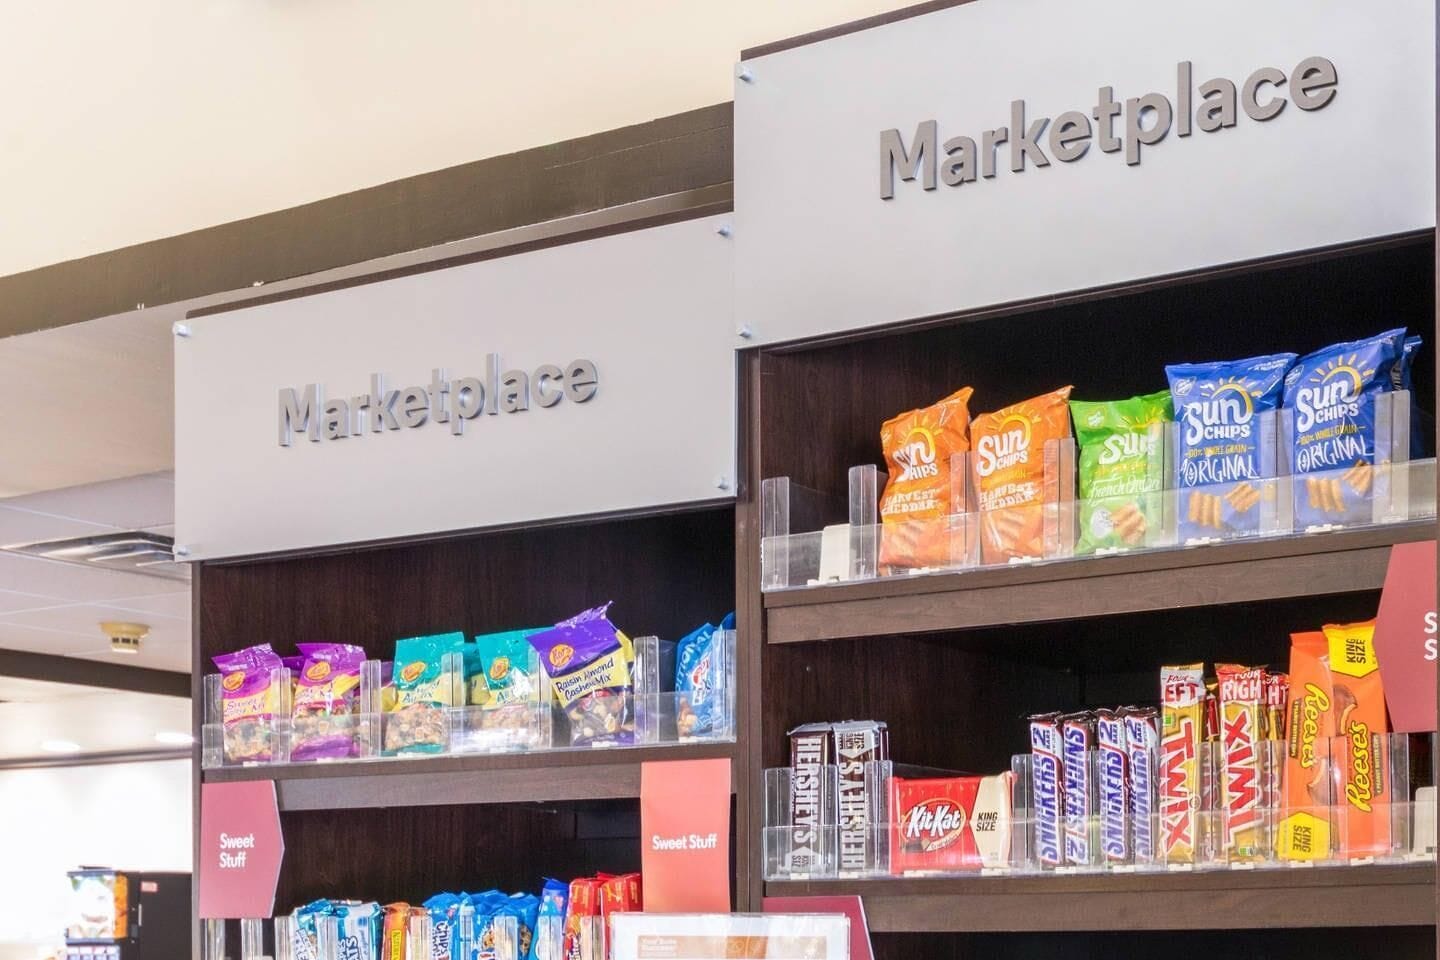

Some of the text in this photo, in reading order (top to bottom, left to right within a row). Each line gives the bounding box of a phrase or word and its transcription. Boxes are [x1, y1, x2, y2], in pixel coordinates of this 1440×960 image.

[879, 55, 1338, 200] Marketplace
[278, 353, 599, 447] Marketplace
[1296, 378, 1360, 433] Sun
[1316, 402, 1359, 423] CHIPS
[1185, 398, 1252, 446] Sun
[1204, 424, 1250, 440] CHIPS
[976, 428, 1031, 477] Sun
[995, 450, 1029, 470] CHIPS
[1346, 638, 1356, 664] KING
[1356, 638, 1366, 664] SIZE
[556, 658, 615, 693] Raisin Almond
[564, 674, 613, 702] Cashew Mix
[1033, 729, 1047, 747] 2
[1100, 724, 1112, 744] 2
[1224, 710, 1263, 846] TWIX
[1347, 721, 1372, 813] Reese's
[1161, 721, 1196, 852] TWIX
[975, 822, 997, 832] SIZE
[977, 811, 999, 823] KING
[220, 833, 255, 850] Sweet
[652, 833, 718, 851] Sweet Stuff
[1293, 825, 1302, 852] SIZE
[1302, 826, 1312, 853] KING
[219, 853, 247, 869] Stuff
